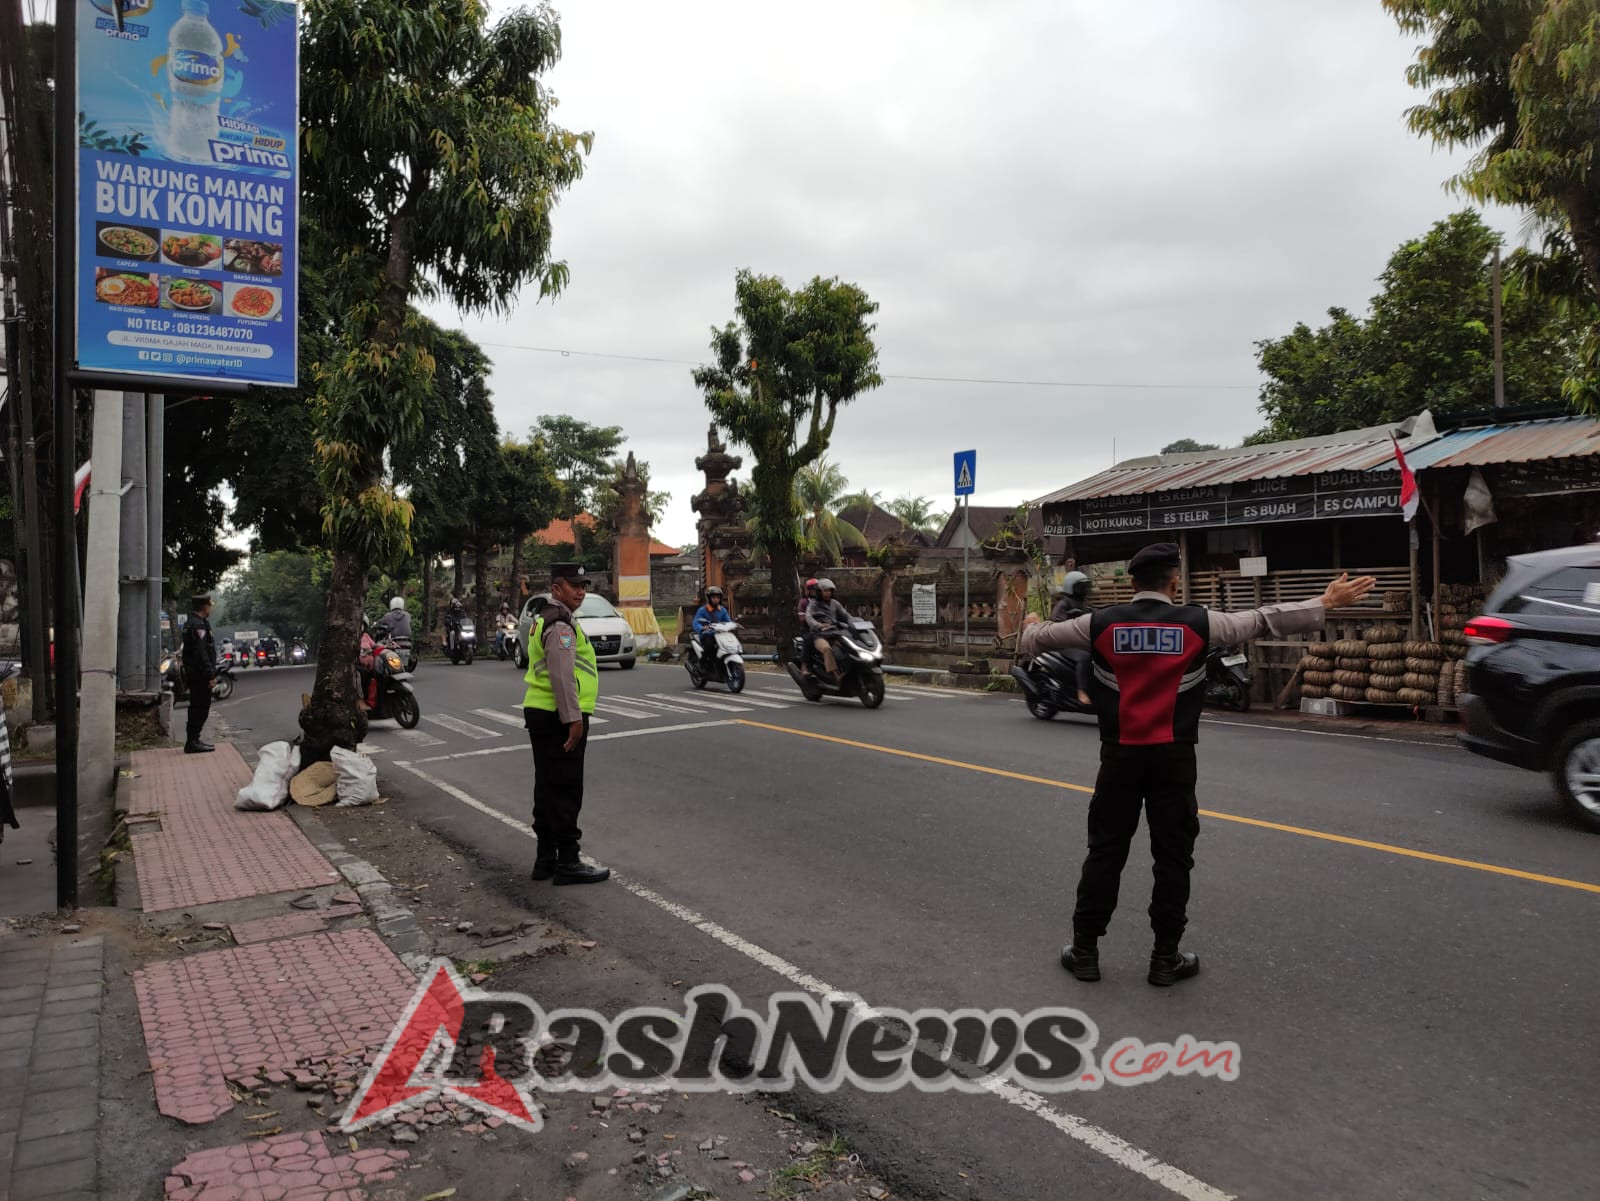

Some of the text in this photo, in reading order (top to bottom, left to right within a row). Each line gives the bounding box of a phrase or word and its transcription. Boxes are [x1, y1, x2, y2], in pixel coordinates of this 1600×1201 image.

[173, 59, 220, 77] prima
[220, 117, 260, 134] HIDRASI
[254, 136, 283, 149] HIDUP
[213, 142, 289, 168] prima
[96, 159, 284, 205] WARUNG MAKAN
[96, 180, 283, 237] BUK KOMING
[127, 317, 143, 329] NO
[144, 319, 170, 332] TELP
[177, 322, 253, 340] 081236487070
[134, 336, 161, 344] WISMA
[176, 355, 243, 368] @primawaterID
[1251, 479, 1288, 493] JUICE
[1320, 469, 1402, 487] BUAH SEGA
[1159, 487, 1215, 503] ES KELAPA
[1324, 495, 1402, 511] ES CAMPU
[1164, 510, 1209, 524] ES TELER
[1243, 503, 1296, 517] ES BUAH
[1086, 515, 1143, 529] ROTI KUKUS
[1115, 628, 1181, 652] POLISI
